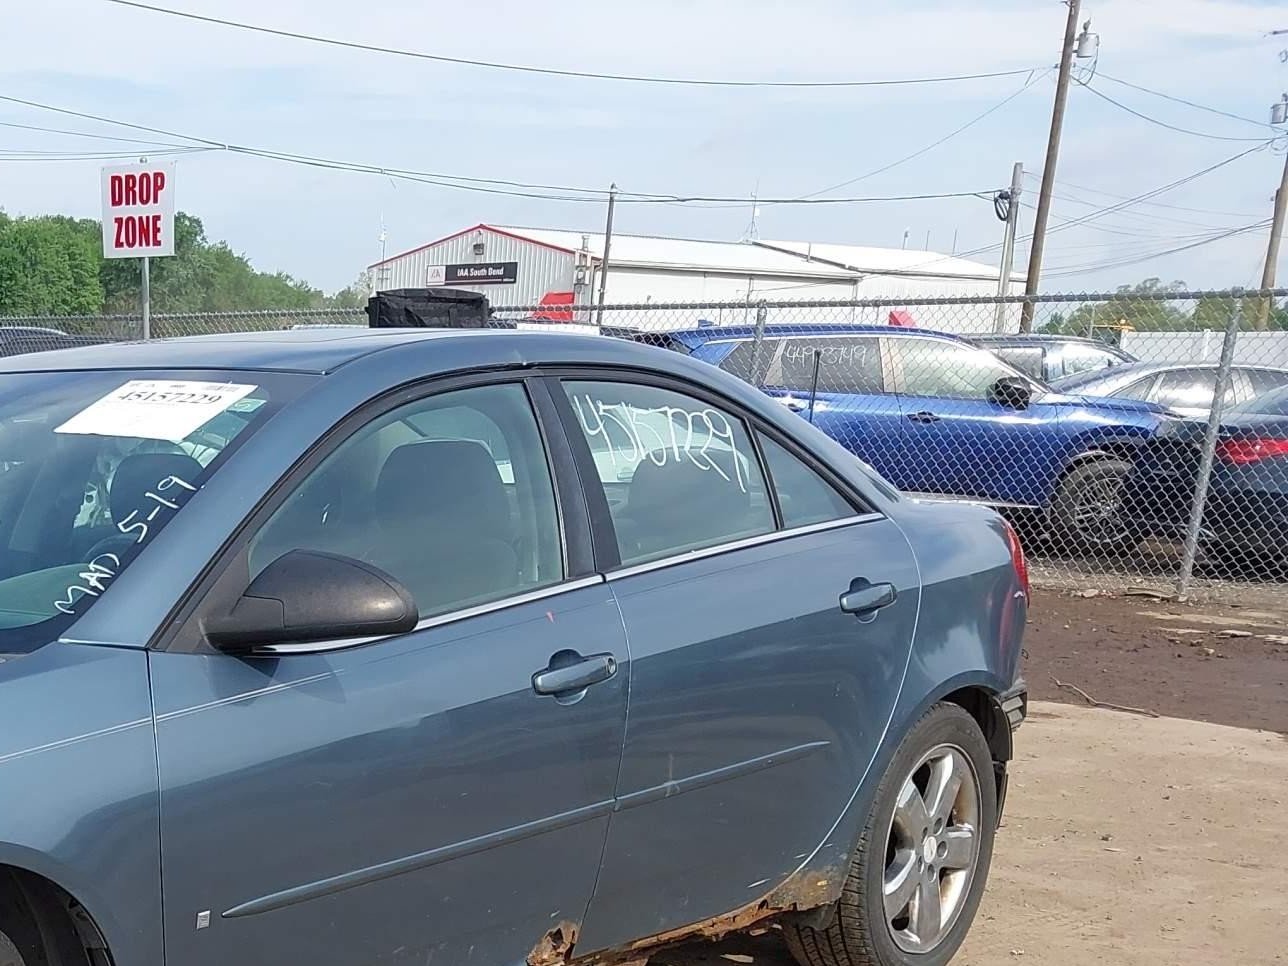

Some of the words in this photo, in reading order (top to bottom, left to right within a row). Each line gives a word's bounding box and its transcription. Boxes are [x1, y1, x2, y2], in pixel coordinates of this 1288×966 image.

[110, 171, 166, 207] DROP
[113, 214, 162, 249] ZONE
[469, 266, 487, 277] South
[488, 265, 504, 276] Bend
[117, 390, 224, 405] 45157229
[573, 393, 747, 493] 45157229
[54, 552, 120, 614] MAD
